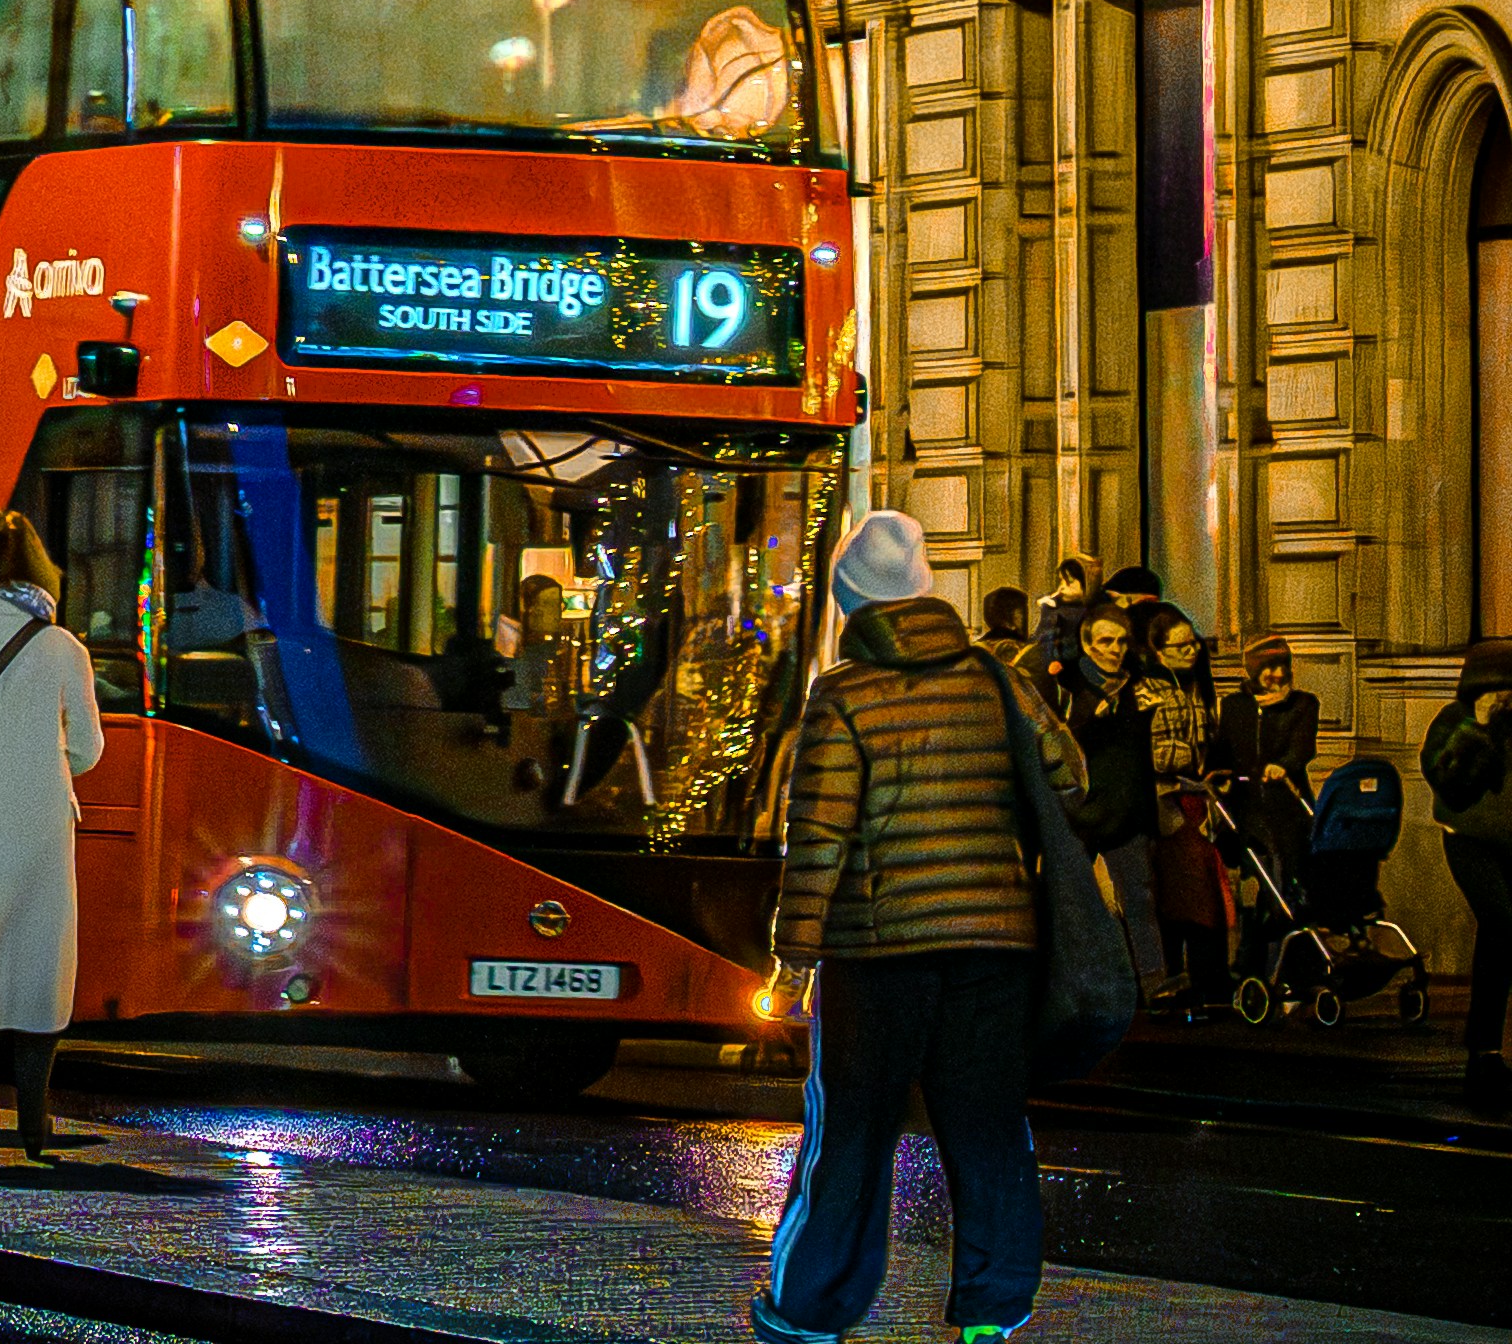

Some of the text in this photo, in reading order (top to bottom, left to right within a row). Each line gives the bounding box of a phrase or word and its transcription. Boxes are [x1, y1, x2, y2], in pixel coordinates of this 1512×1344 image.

[308, 246, 604, 317] Battersea Bridge
[673, 270, 745, 348] 19
[379, 304, 533, 336] SOUTH SIDE
